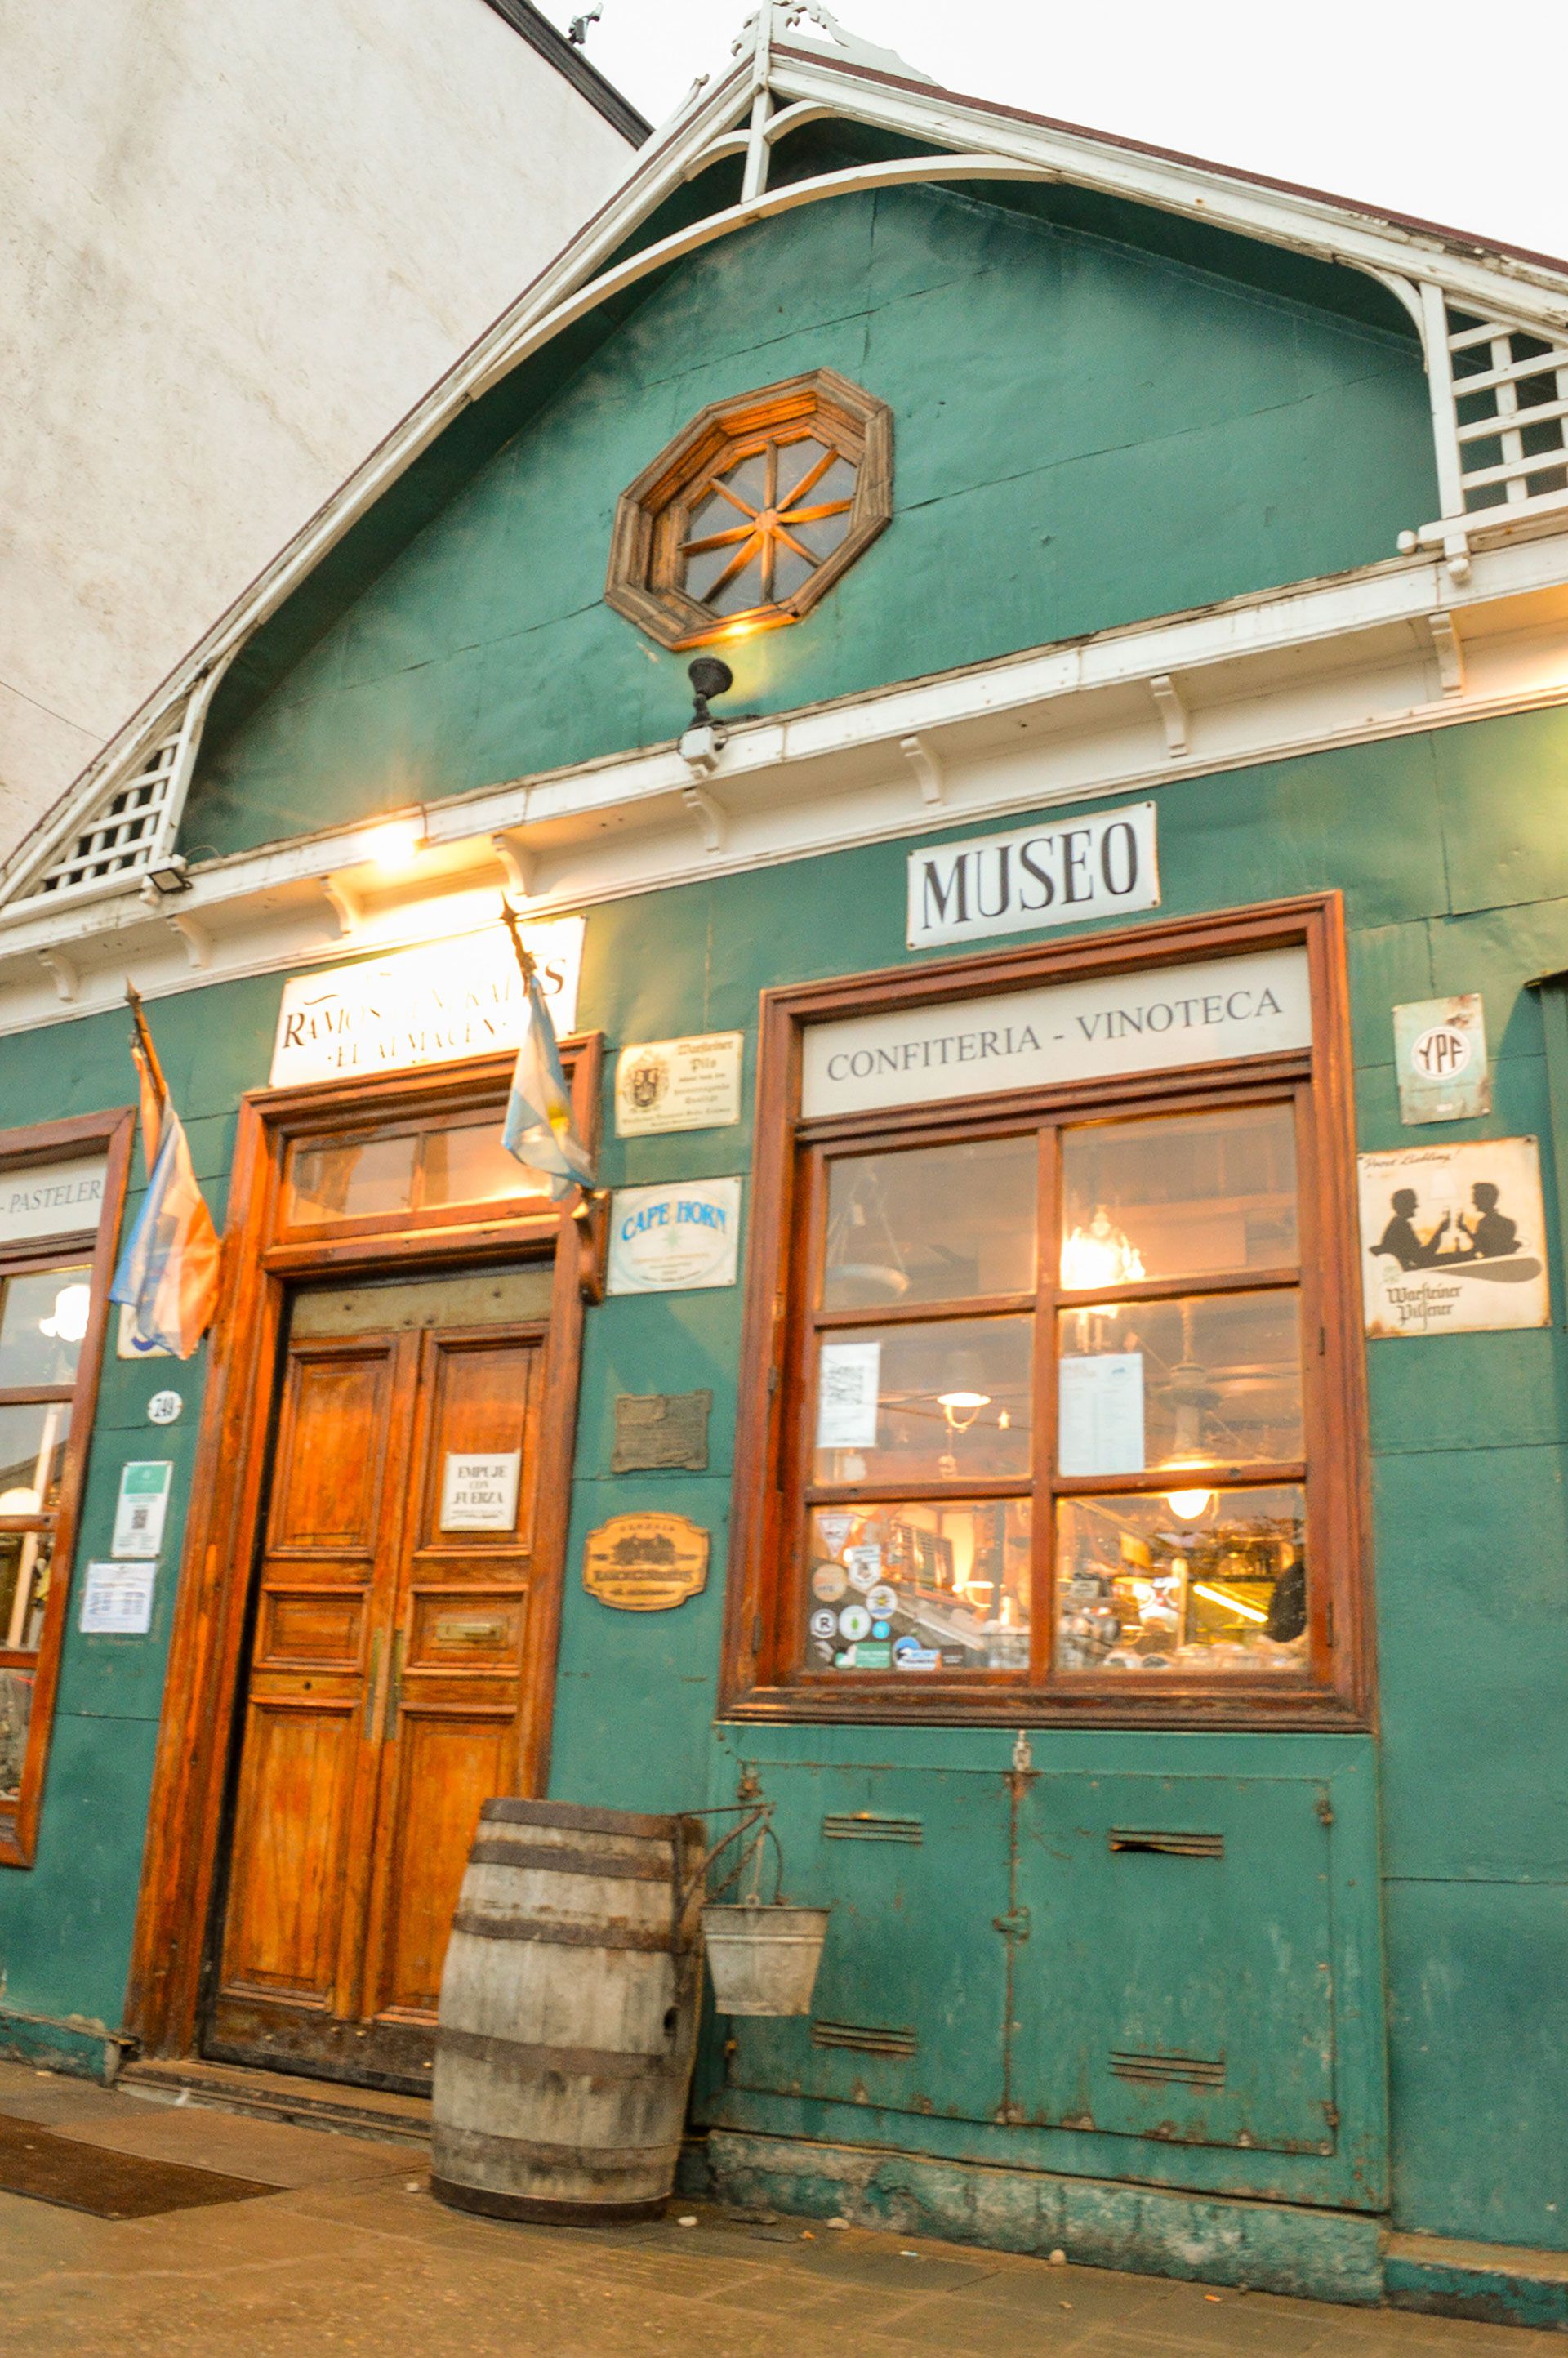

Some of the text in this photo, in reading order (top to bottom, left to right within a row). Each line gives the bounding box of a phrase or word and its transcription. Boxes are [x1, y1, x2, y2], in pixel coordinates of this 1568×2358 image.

[921, 822, 1139, 930] MUSEO
[826, 1025, 1042, 1081] CONFITERIA
[1076, 987, 1285, 1041] VINOTECA
[1419, 1033, 1463, 1073] YPF
[621, 1200, 727, 1241] CAPE HORN
[457, 1465, 507, 1478] EMPUJE
[453, 1491, 504, 1504] FUERZA
